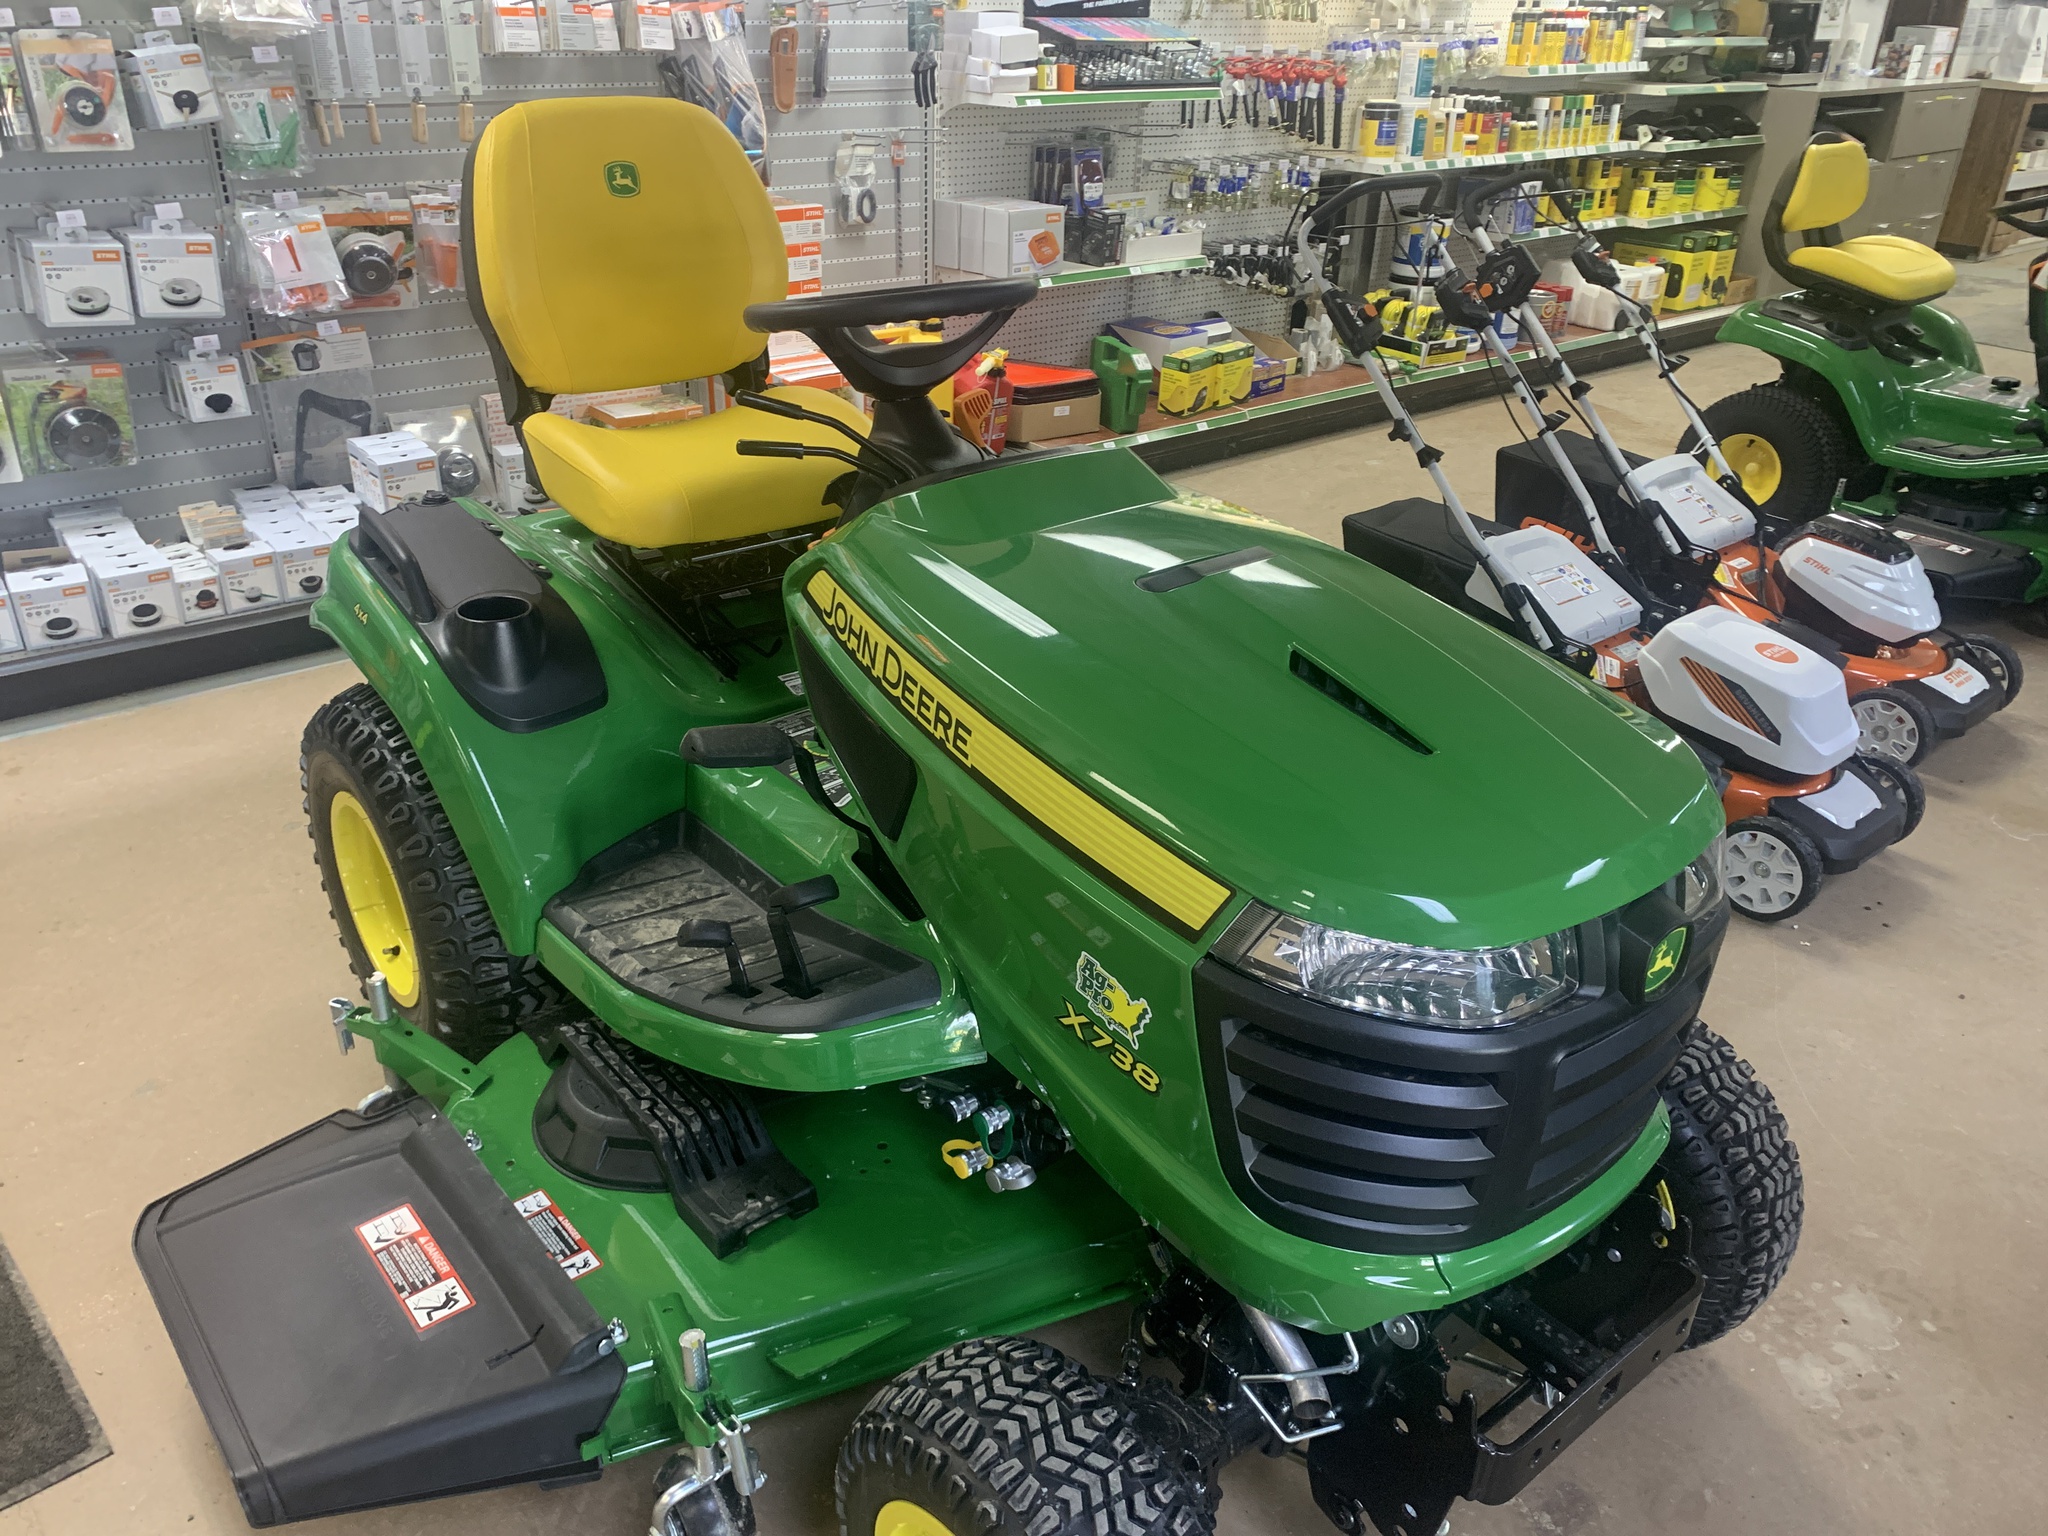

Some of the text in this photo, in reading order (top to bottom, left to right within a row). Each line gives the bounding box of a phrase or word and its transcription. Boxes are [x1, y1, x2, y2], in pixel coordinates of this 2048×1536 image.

[802, 246, 820, 254] STIHL
[803, 283, 820, 291] STIHL
[94, 367, 120, 375] STIHL
[1802, 556, 1831, 576] STIHL
[823, 587, 973, 761] JOHN DEERE
[1943, 667, 1969, 684] STIHL
[1735, 688, 1773, 734] BRUSHLESS
[1079, 974, 1114, 1012] Pro
[1057, 999, 1161, 1093] X738
[423, 1241, 451, 1274] DANGER
